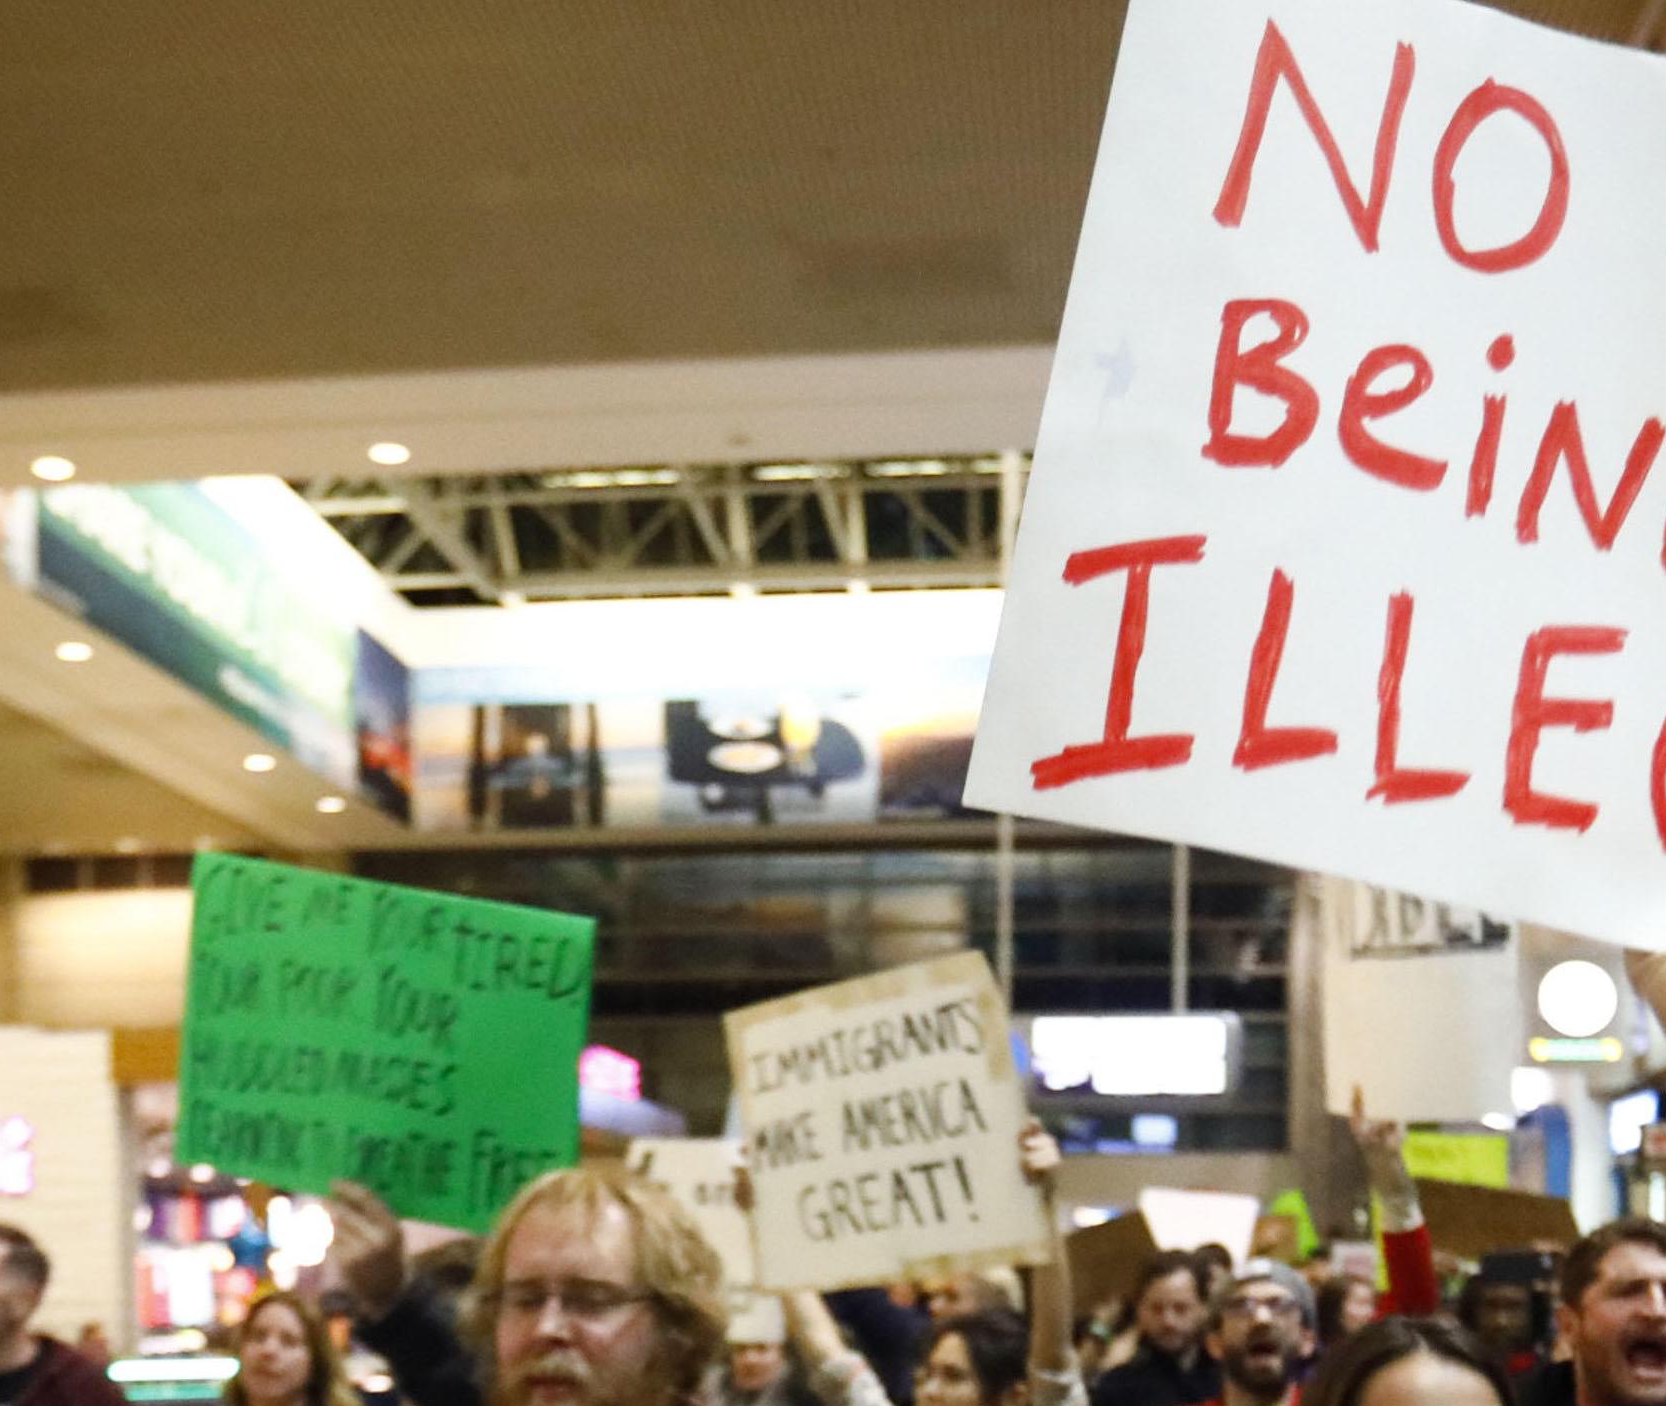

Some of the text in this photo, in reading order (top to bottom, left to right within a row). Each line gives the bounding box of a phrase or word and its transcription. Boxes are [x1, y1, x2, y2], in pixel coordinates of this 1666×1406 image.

[1215, 23, 1568, 272] NO
[751, 998, 983, 1094] IMMIGRANTS
[752, 1076, 989, 1174] MAKE AMERICA
[798, 1154, 980, 1242] GREAT!
